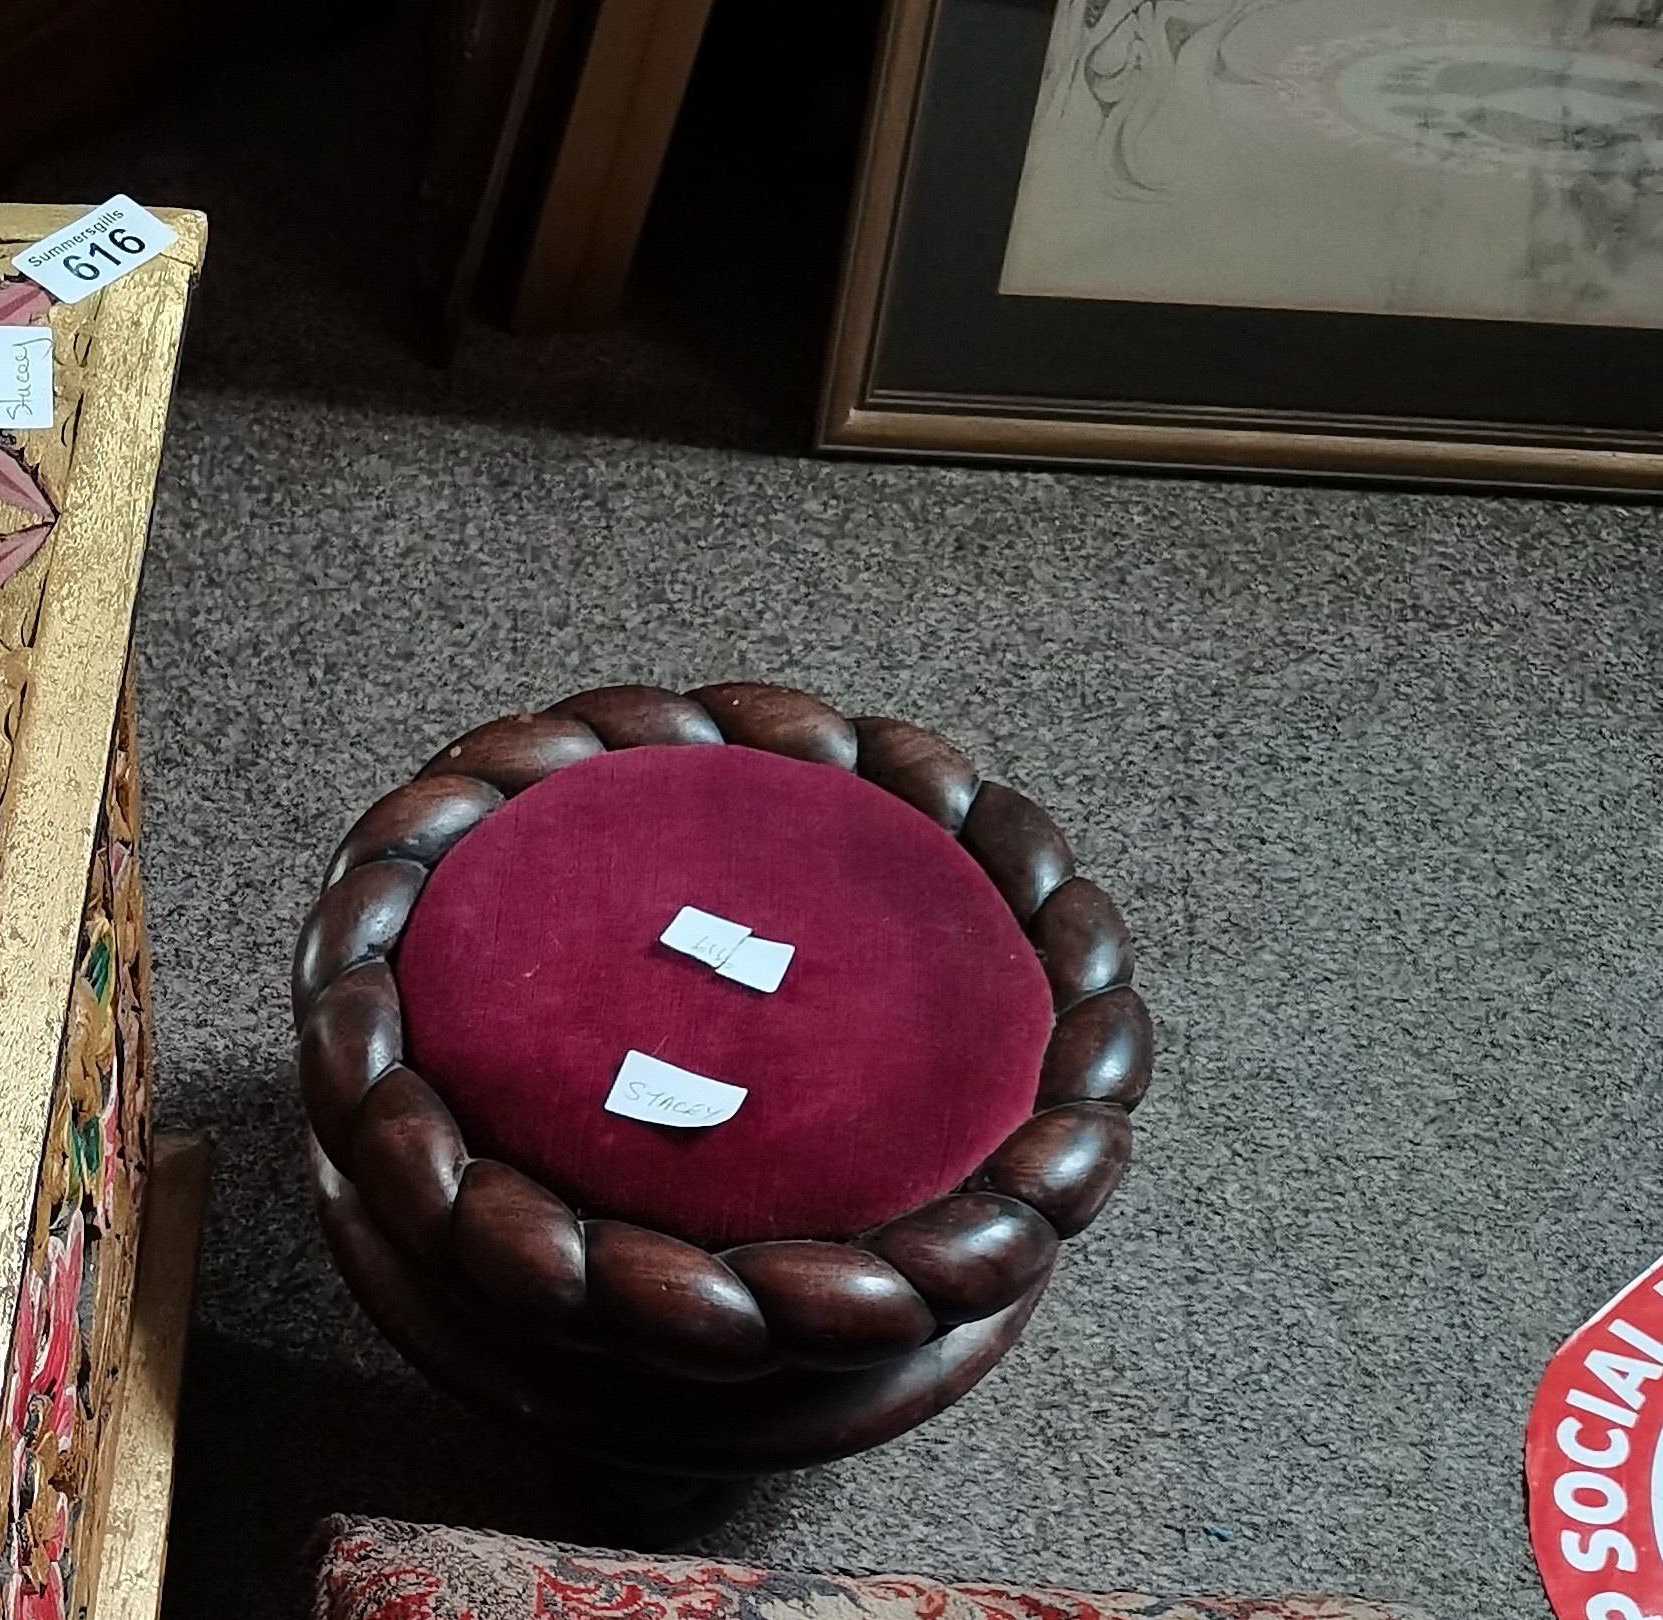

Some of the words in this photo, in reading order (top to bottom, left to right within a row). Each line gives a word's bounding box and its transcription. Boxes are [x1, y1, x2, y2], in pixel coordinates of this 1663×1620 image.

[27, 208, 125, 268] Summersgills
[62, 228, 146, 281] 616
[624, 1080, 725, 1120] STACEY
